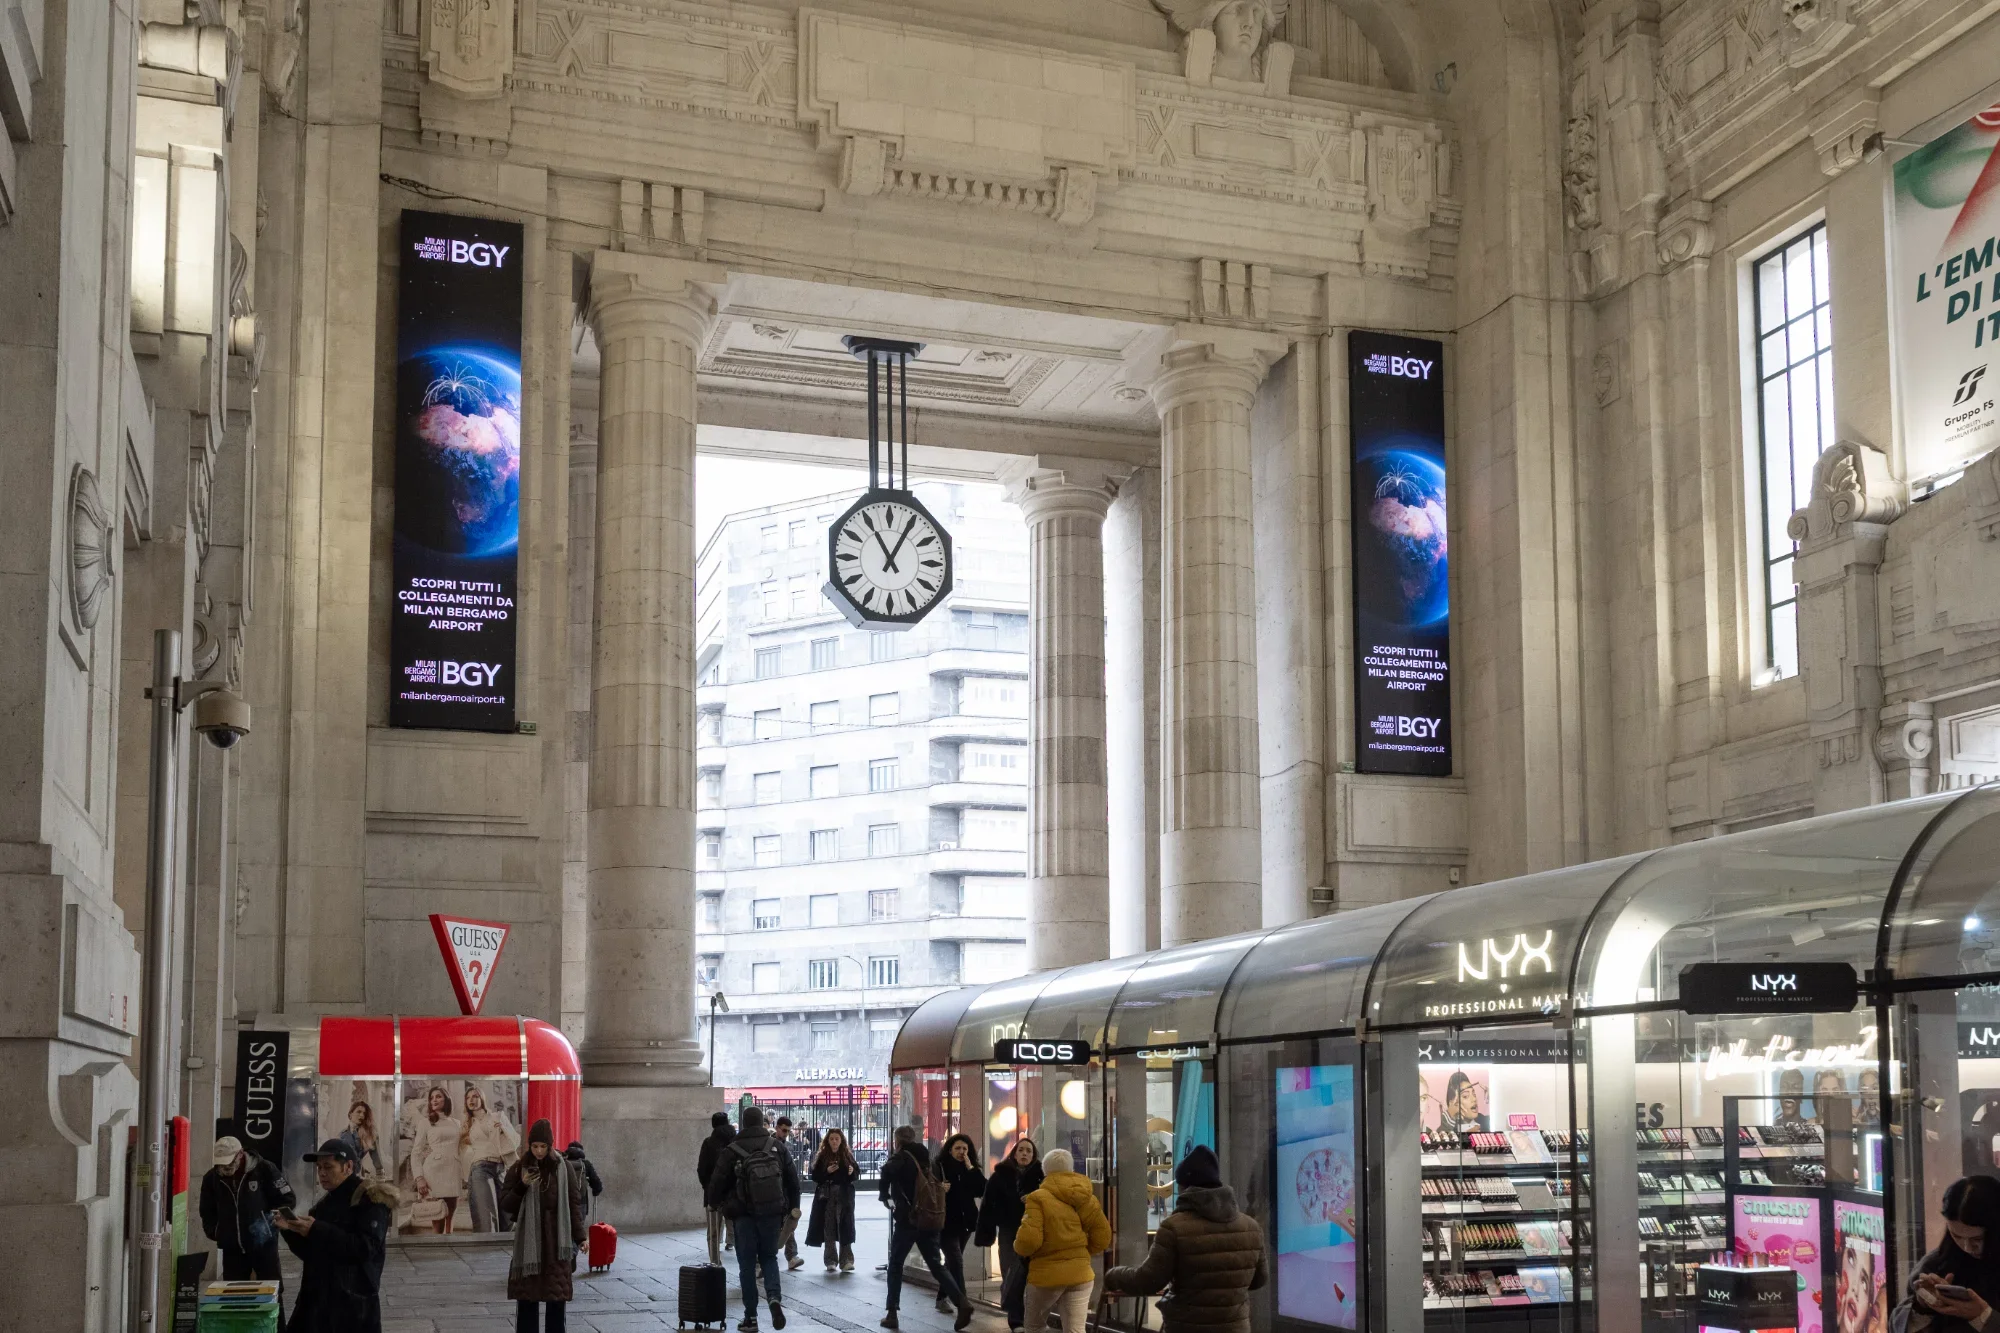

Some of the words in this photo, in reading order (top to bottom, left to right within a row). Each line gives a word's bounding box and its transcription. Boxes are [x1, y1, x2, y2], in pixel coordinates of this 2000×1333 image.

[414, 243, 446, 254] BERGAMO
[424, 237, 446, 246] MILAN
[419, 251, 446, 261] AIRPORT
[451, 239, 510, 268] BGY
[1916, 236, 2000, 303] L'EM
[1946, 281, 1983, 325] DI
[1391, 355, 1434, 380] BGY
[1944, 407, 1981, 427] Gruppo
[1983, 399, 1994, 411] FS
[1969, 419, 1995, 434] PARTNER
[411, 578, 457, 590] SCOPRI
[459, 581, 494, 592] TUTTI
[497, 583, 501, 593] I
[398, 590, 493, 606] COLLEGAMENTI
[496, 597, 514, 607] DA
[403, 604, 443, 616] MILAN
[446, 606, 508, 620] BERGAMO
[428, 619, 484, 632] AIRPORT
[1373, 646, 1406, 656] SCOPRI
[1408, 648, 1433, 658] TUTTI
[1435, 650, 1439, 658] I
[415, 660, 436, 669] MILAN
[1364, 656, 1433, 669] COLLEGAMENTI
[1434, 661, 1448, 670] DA
[404, 667, 437, 676] BERGAMO
[442, 661, 502, 687] BGY
[1368, 668, 1397, 678] MILAN
[1399, 670, 1444, 681] BERGAMO
[409, 675, 437, 683] AIRPORT
[1386, 681, 1427, 691] AIRPORT
[400, 691, 505, 704] milanbergamoairport.it
[1398, 716, 1441, 738] BGY
[1368, 742, 1445, 753] milanbergamoairport.it
[1458, 929, 1553, 983] NYX
[1752, 974, 1797, 991] NYX
[1425, 998, 1524, 1017] PROFESSIONAL
[1013, 1043, 1074, 1062] IQOS
[1451, 1049, 1541, 1057] PROFESSIONAL
[795, 1067, 866, 1081] ALEMAGNA
[245, 1042, 277, 1140] GUESS
[1708, 1288, 1730, 1300] NYX
[1757, 1291, 1782, 1301] NYX
